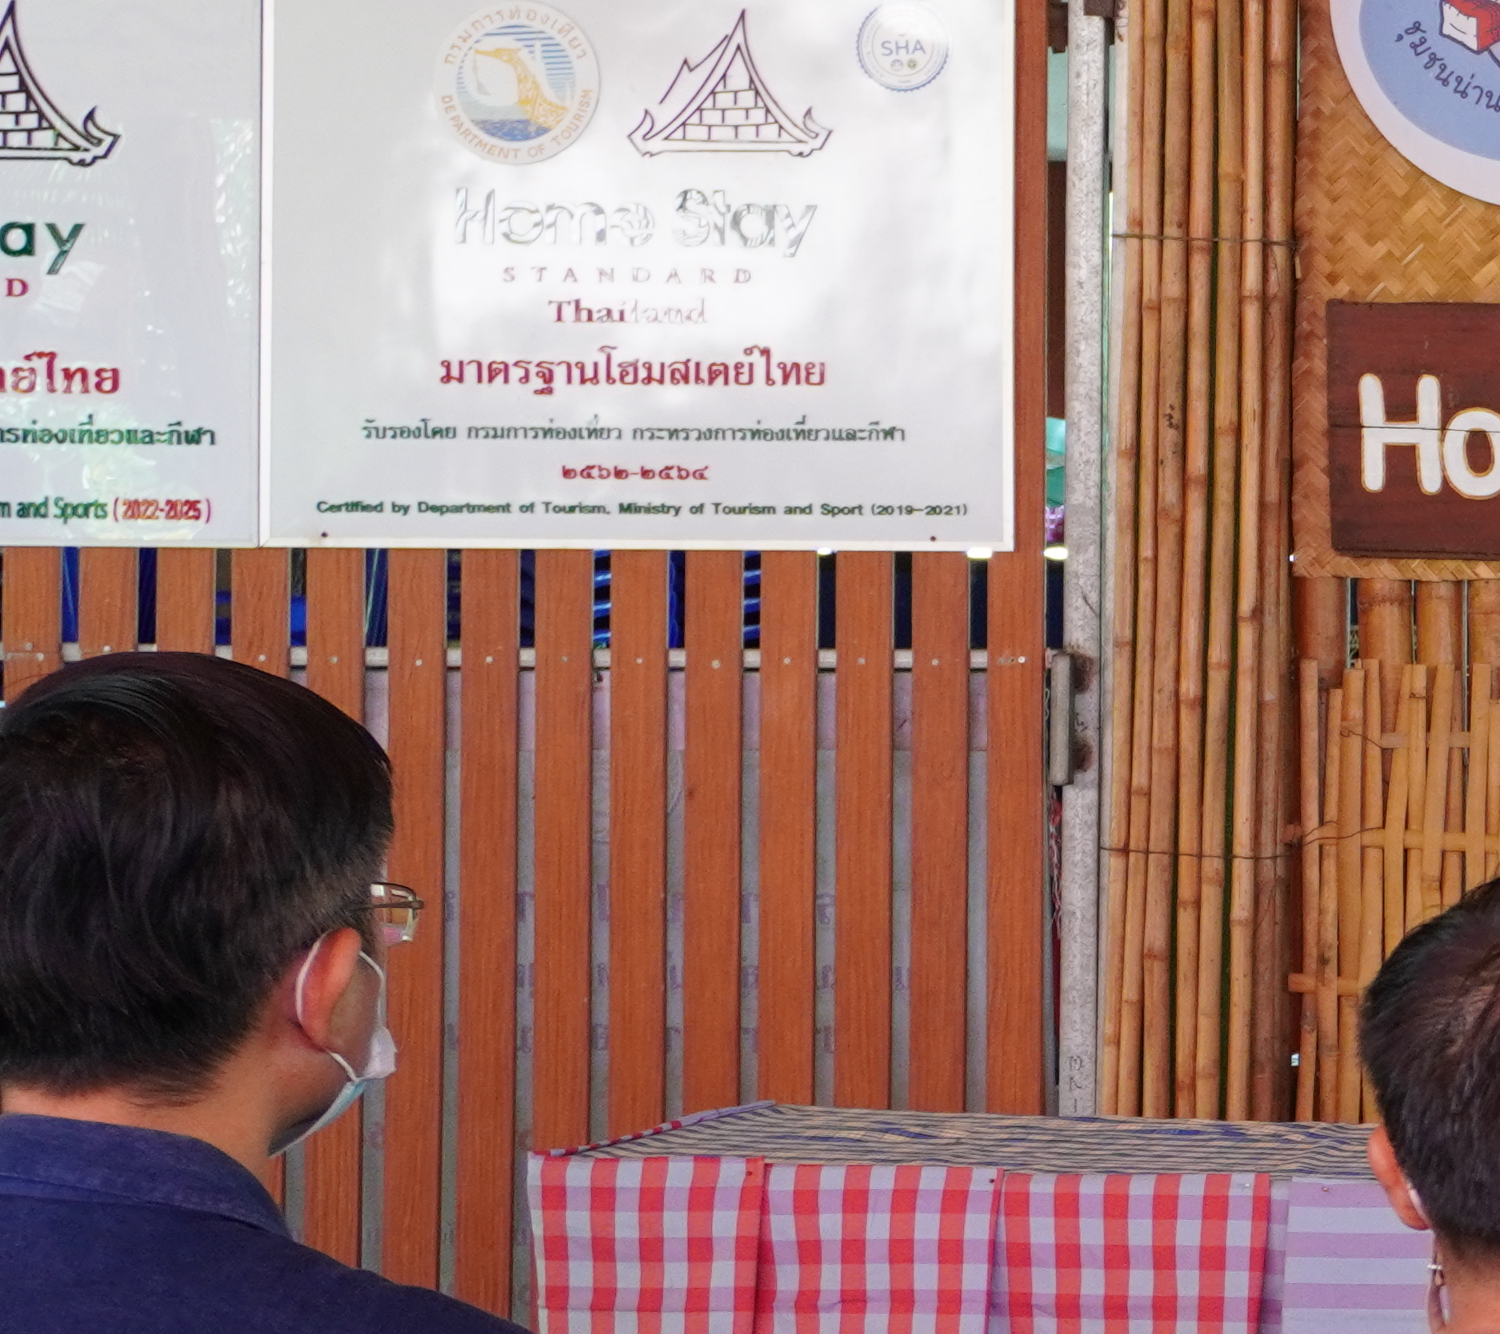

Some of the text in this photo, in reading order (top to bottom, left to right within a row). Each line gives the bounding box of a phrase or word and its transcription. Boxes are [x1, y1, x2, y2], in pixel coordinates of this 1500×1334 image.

[881, 39, 926, 56] SHA
[442, 89, 593, 159] DEPARTMENT OF TOURISM
[455, 188, 818, 257] Home Stay
[4, 278, 29, 298] D
[504, 267, 753, 284] STANDARD
[548, 299, 708, 324] Thailand
[441, 346, 826, 395] มาตรฐานโฮมสเตย์ไทย
[362, 414, 906, 443] รับรองโดย กรมการท่องเที่ยว กระทรวงการท่องเที่ยวและกีฬา
[15, 495, 49, 519] and
[54, 496, 108, 526] Sports
[316, 500, 384, 515] Certified
[390, 500, 410, 518] by
[417, 500, 512, 518] Department
[519, 500, 536, 515] of
[618, 500, 682, 519] Ministry
[689, 500, 706, 515] of
[712, 500, 776, 517] Tourism
[784, 501, 812, 517] and
[820, 501, 863, 519] Sport
